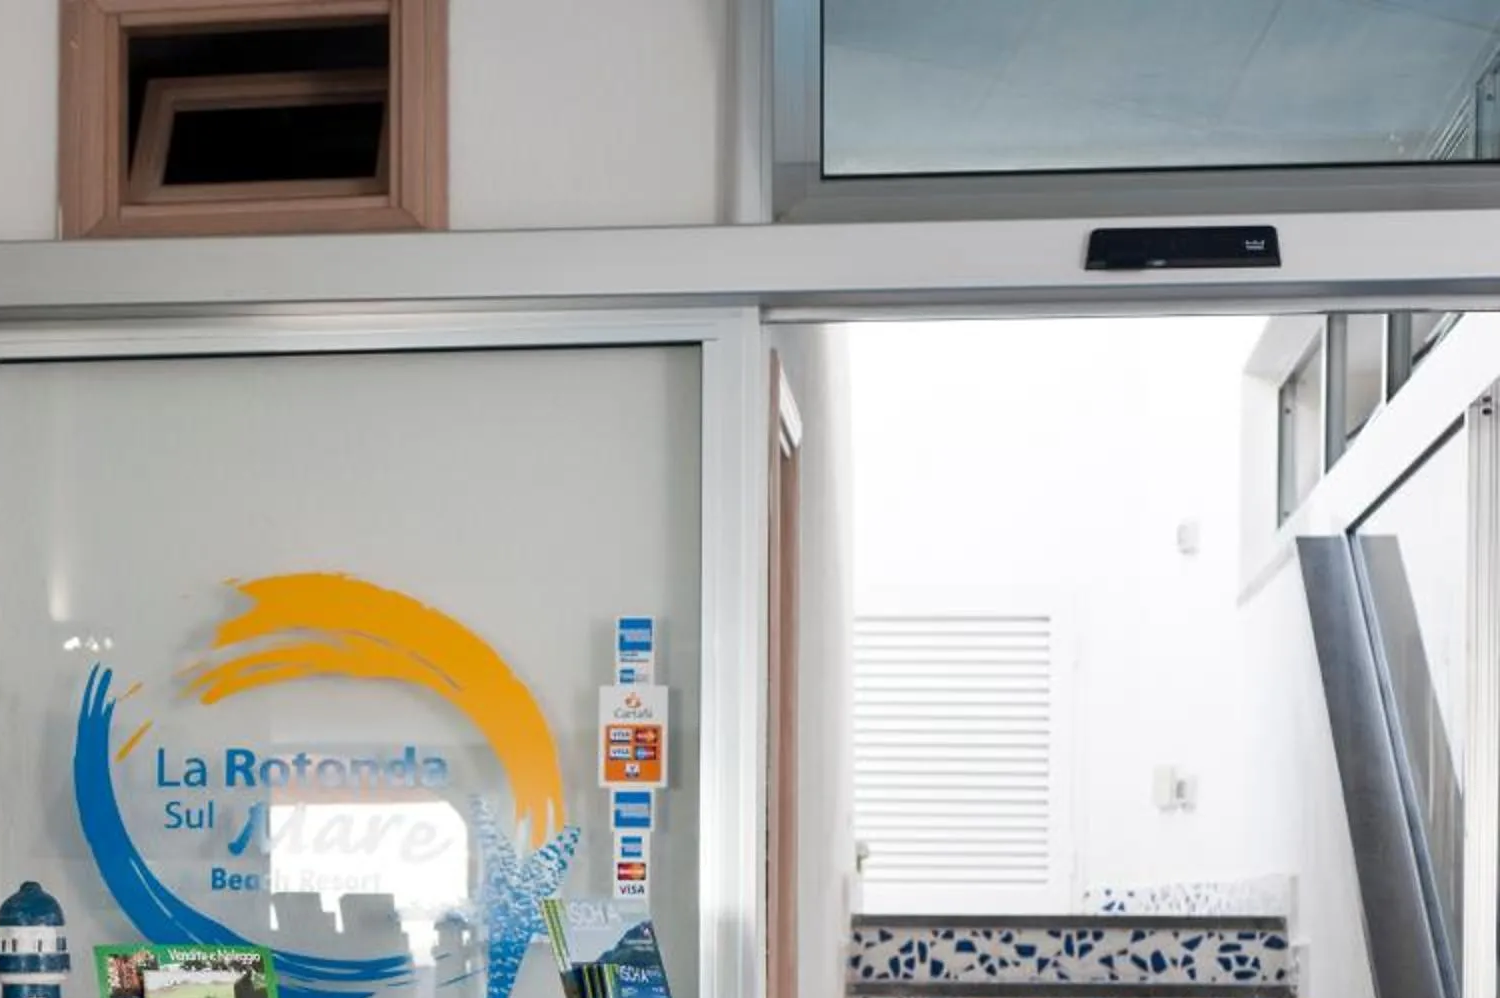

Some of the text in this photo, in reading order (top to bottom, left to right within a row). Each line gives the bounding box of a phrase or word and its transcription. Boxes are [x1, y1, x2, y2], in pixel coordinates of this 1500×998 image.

[157, 746, 448, 787] La Rotonda
[164, 800, 455, 864] Sul Mare
[211, 868, 288, 890] Beach
[619, 884, 645, 895] VISA
[218, 949, 260, 966] Noleggio
